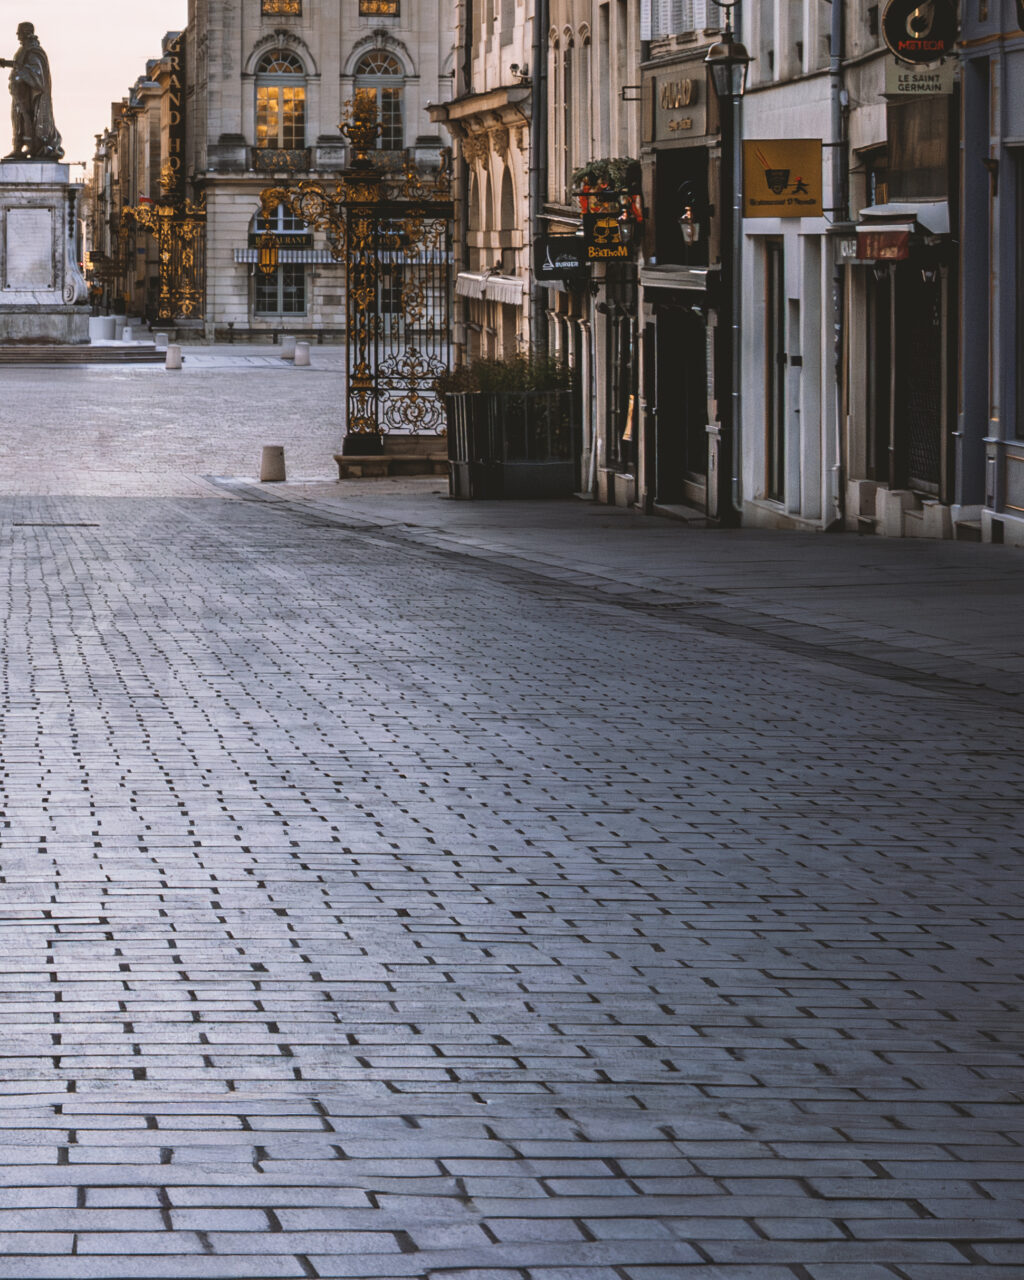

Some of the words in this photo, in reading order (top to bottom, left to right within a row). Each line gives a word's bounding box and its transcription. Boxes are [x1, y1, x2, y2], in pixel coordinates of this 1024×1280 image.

[898, 40, 944, 51] METEOR
[168, 39, 181, 126] GRAND
[898, 74, 910, 83] LE
[912, 74, 940, 83] SAINT
[898, 83, 942, 92] GERMAIN
